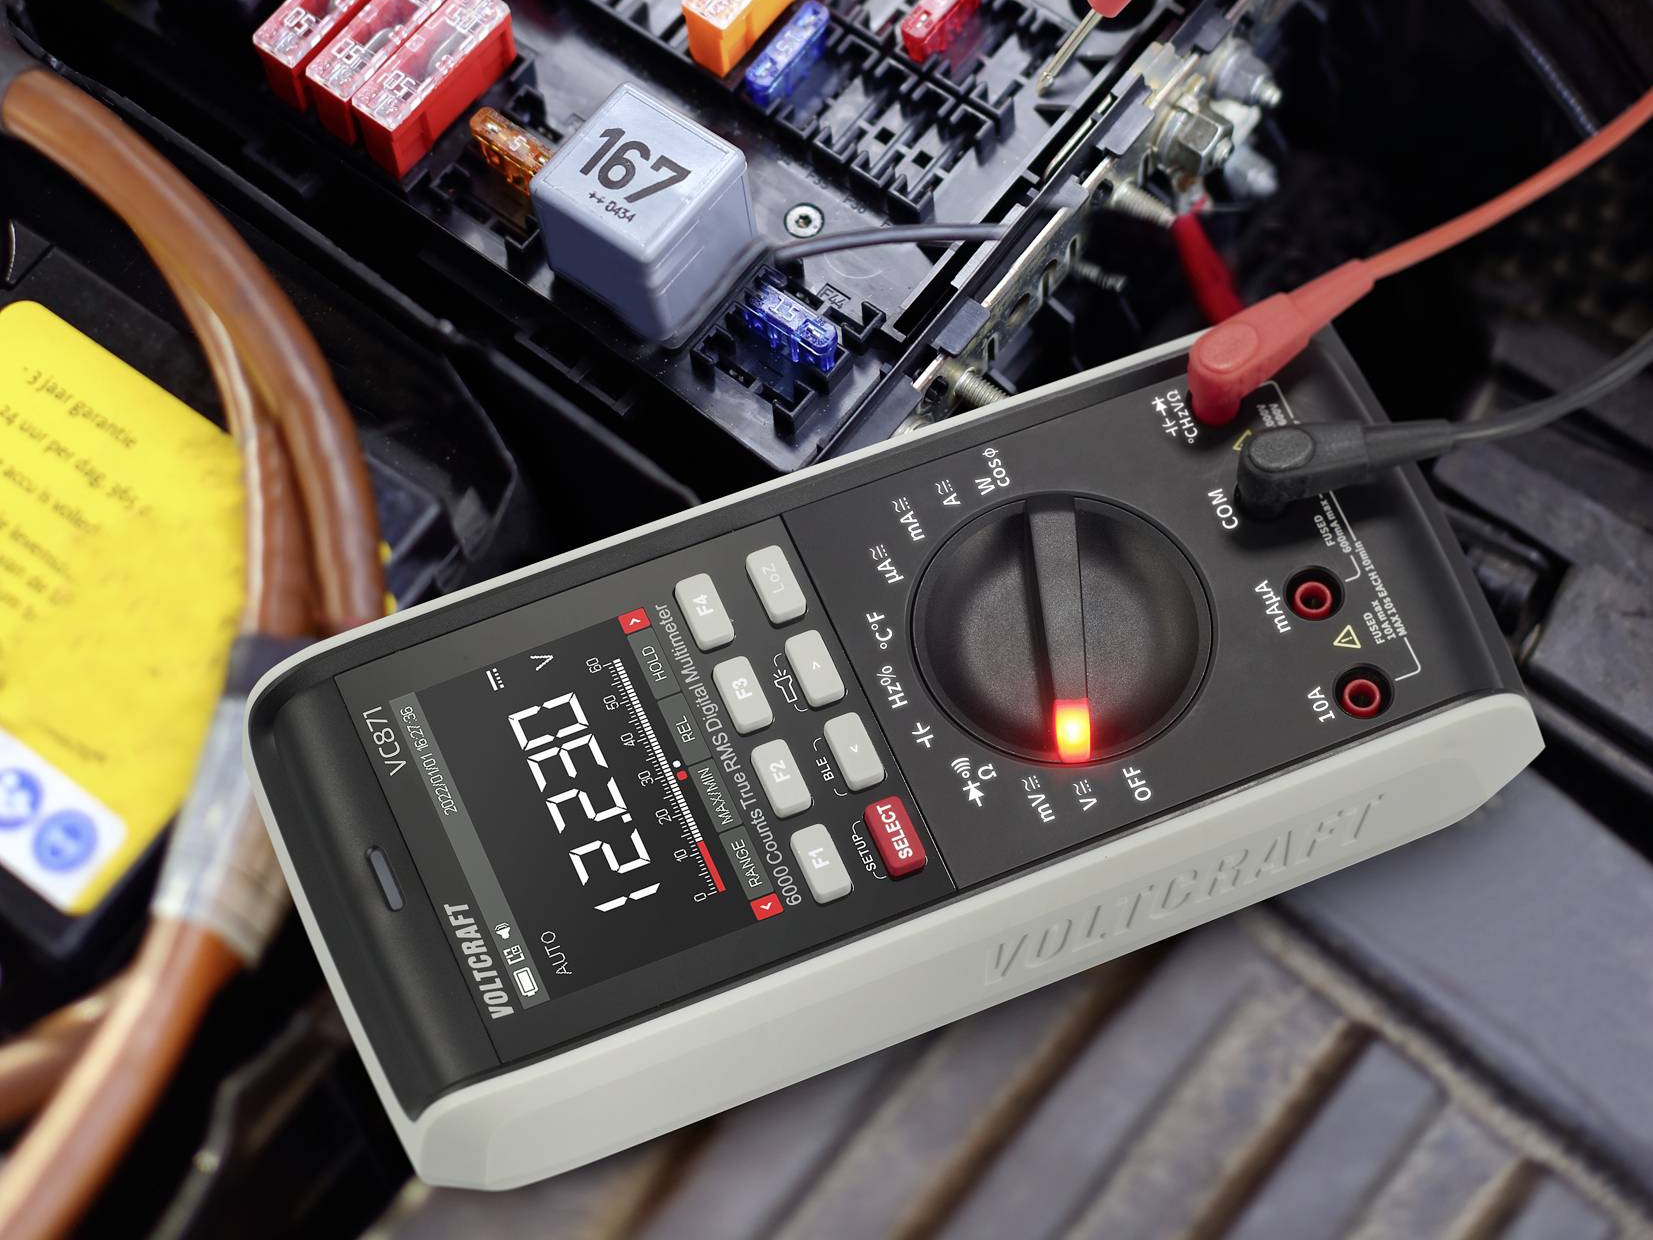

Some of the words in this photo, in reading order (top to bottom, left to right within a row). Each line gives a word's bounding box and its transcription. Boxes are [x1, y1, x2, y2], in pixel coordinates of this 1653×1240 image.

[773, 28, 802, 57] 15
[578, 127, 691, 204] 167
[604, 199, 636, 223] 0434
[767, 294, 801, 323] 15
[817, 285, 847, 310] F44
[36, 375, 74, 401] jaar
[69, 401, 136, 447] garantie
[1255, 402, 1276, 431] 000V
[974, 476, 995, 495] W
[1207, 487, 1238, 529] COM
[1319, 498, 1338, 524] max
[1313, 514, 1336, 547] FUSED
[1329, 520, 1352, 553] 600mA
[1354, 540, 1375, 571] 10min
[760, 561, 785, 593] LoZ
[1367, 570, 1388, 598] EACH
[692, 593, 714, 616] F4
[1370, 599, 1387, 621] max
[1382, 596, 1397, 614] 10s
[1362, 611, 1385, 644] FUSED
[1380, 619, 1396, 640] 10A
[1389, 613, 1407, 636] MAX
[654, 603, 700, 683] Multimeter
[529, 653, 554, 671] V
[585, 656, 602, 673] 60
[641, 644, 667, 681] HOLD
[602, 693, 619, 710] 50
[731, 676, 753, 699] F3
[876, 664, 908, 708] Hz%
[688, 681, 723, 732] Digital
[1306, 685, 1335, 722] 10A
[362, 705, 406, 776] VC871
[399, 705, 428, 751] 16:27:36
[619, 731, 635, 746] 40
[675, 714, 695, 742] REL
[711, 731, 741, 772] RMS
[419, 752, 458, 815] 2022/01/01
[637, 769, 654, 786] 30
[769, 758, 791, 782] F2
[815, 755, 835, 781] BLE
[1122, 766, 1152, 801] OFF
[507, 691, 660, 912] 12.230
[697, 766, 734, 824] MAX/MIN
[733, 771, 757, 809] True
[654, 807, 672, 825] 20
[875, 803, 913, 859] SELECT
[749, 807, 783, 864] Counts
[673, 847, 688, 862] 10
[730, 838, 763, 887] RANGE
[807, 846, 830, 869] F1
[851, 833, 877, 871] SETUP
[693, 891, 707, 902] 0
[772, 864, 802, 905] 6000
[974, 792, 1395, 986] VOLTCRAFT
[443, 903, 514, 1019] VOLTCRAFT
[540, 929, 572, 974] AUTO
